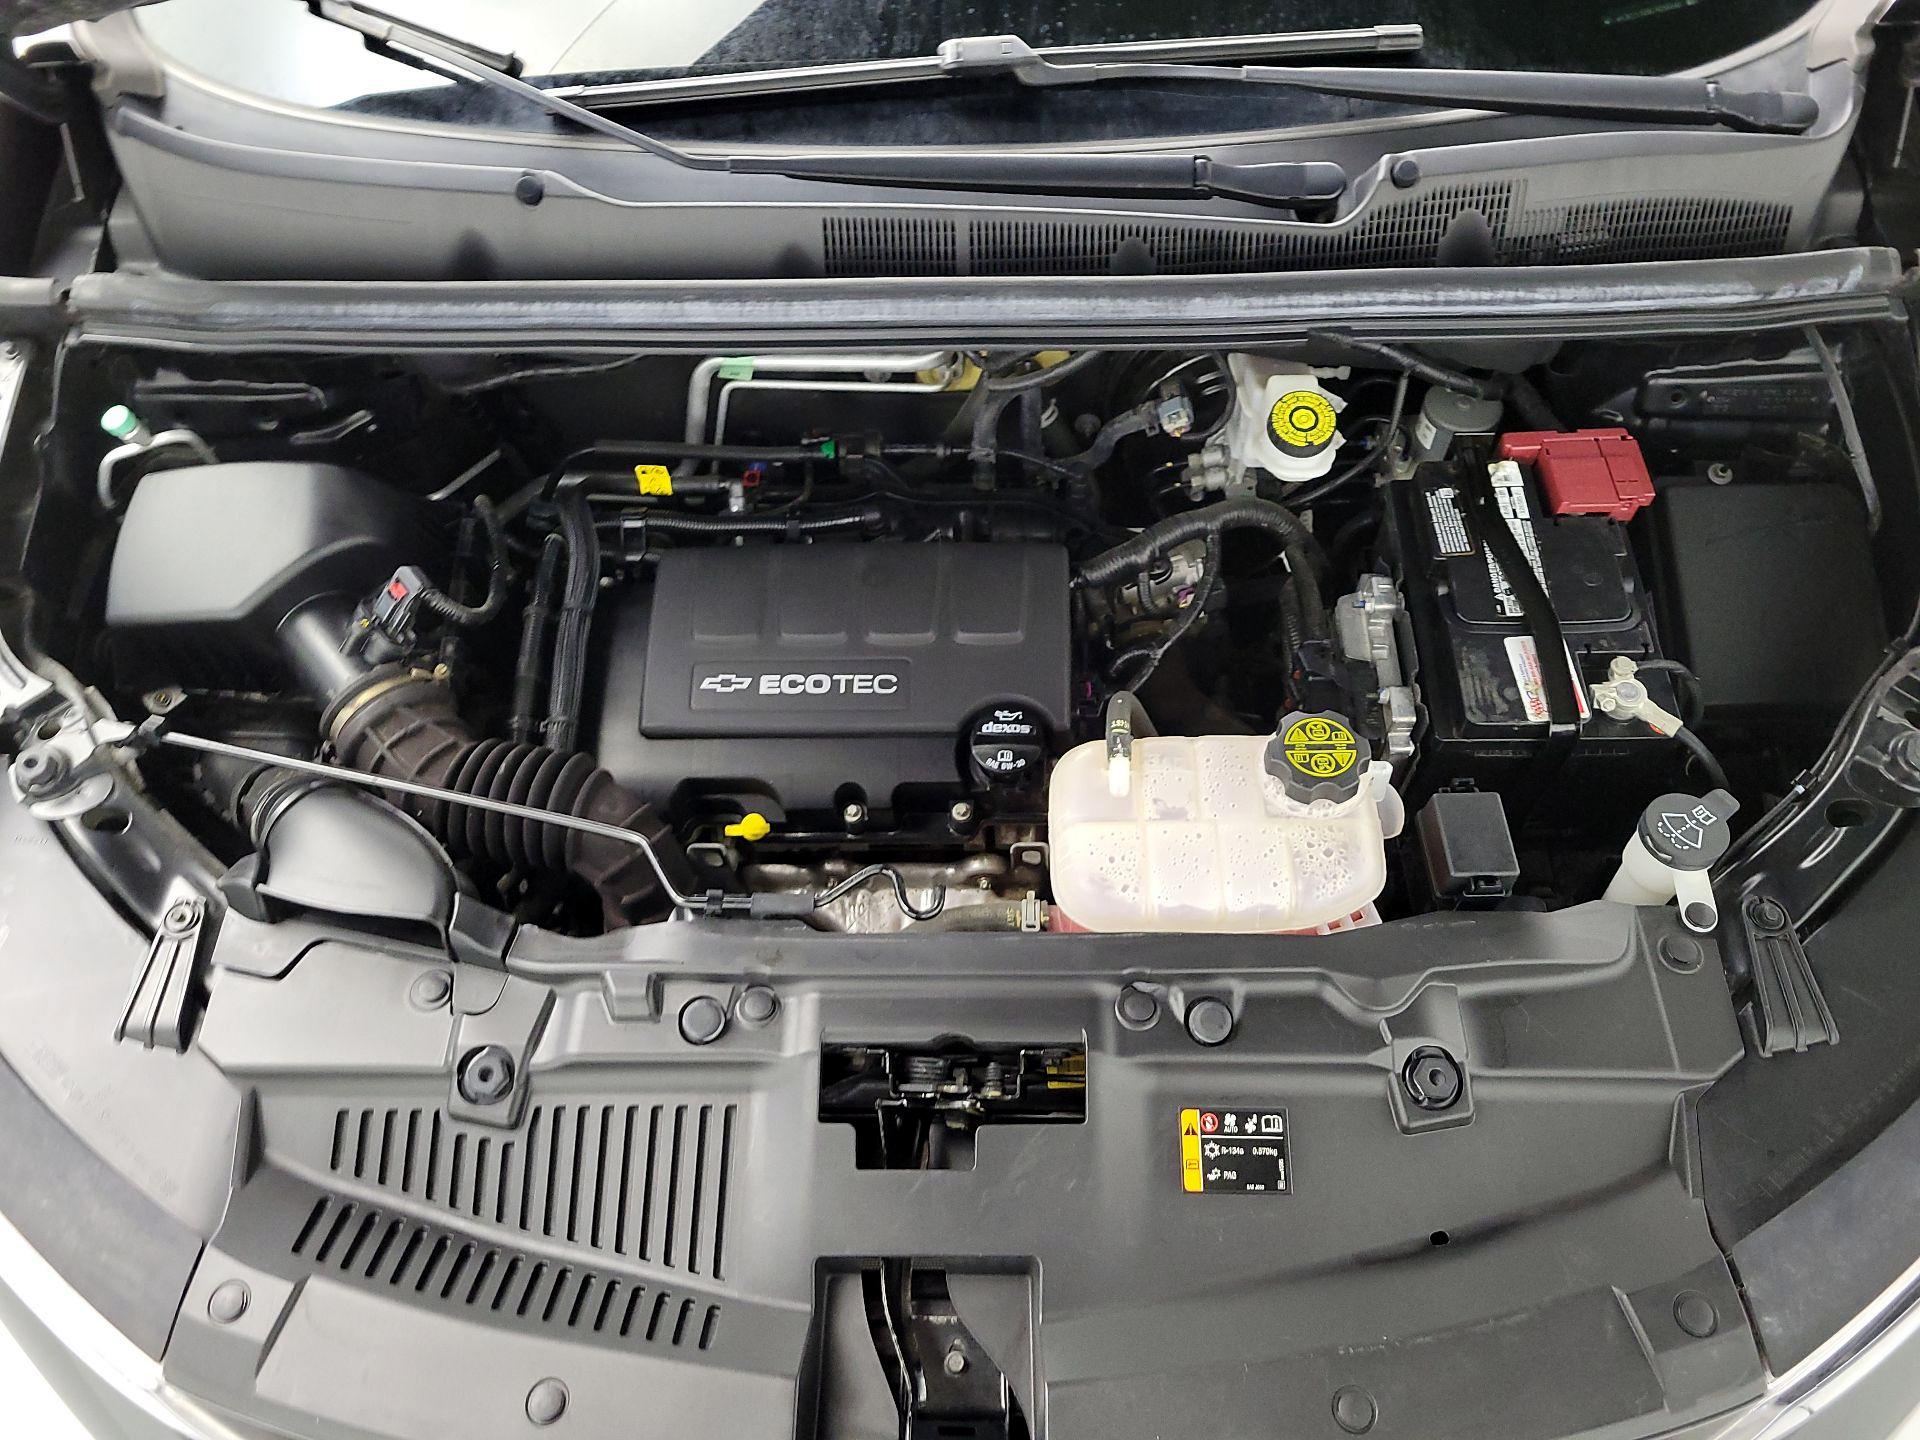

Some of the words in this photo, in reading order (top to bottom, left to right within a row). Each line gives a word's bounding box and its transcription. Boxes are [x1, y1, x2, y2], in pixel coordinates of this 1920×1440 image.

[759, 674, 898, 695] ECOTEC
[981, 721, 1032, 734] dexos
[1223, 1125, 1239, 1134] AUTO
